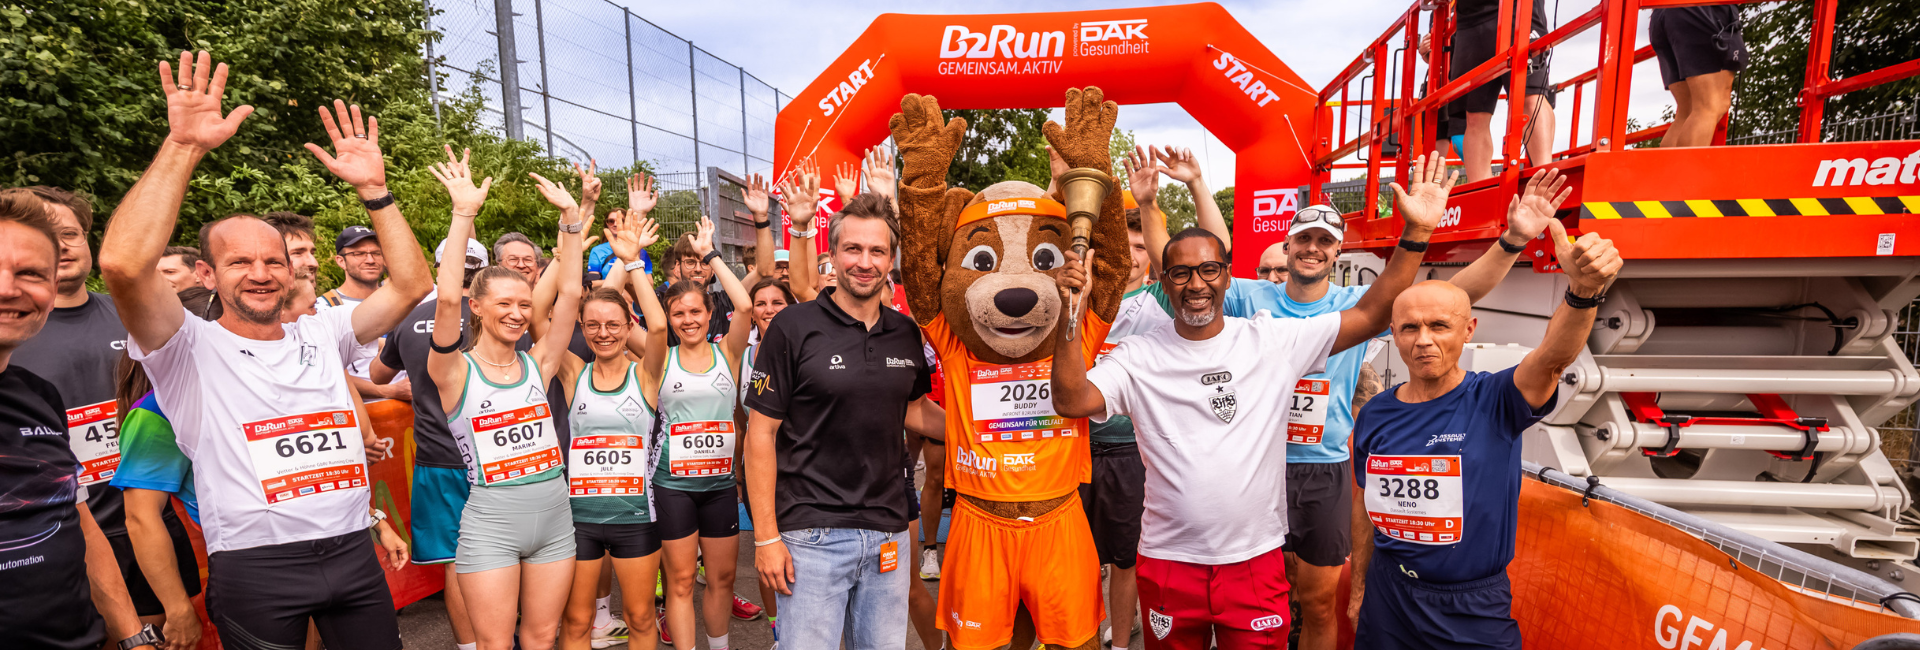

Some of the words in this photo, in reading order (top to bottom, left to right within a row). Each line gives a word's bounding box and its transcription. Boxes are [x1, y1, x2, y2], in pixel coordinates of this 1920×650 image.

[1081, 19, 1149, 42] DAK
[1072, 34, 1080, 57] powered
[1080, 40, 1149, 57] Gesundheit
[818, 58, 875, 117] START
[1213, 52, 1280, 107] START
[1811, 150, 1920, 187] mat
[1253, 188, 1298, 217] DA
[1000, 382, 1050, 402] 2026
[1014, 402, 1038, 410] BUDDY
[1290, 395, 1315, 412] 12
[85, 421, 119, 443] 45
[988, 421, 1025, 430] GEMEINSAM
[1025, 419, 1038, 428] FÜR
[1038, 418, 1065, 427] VIELFALT
[1312, 426, 1320, 434] D
[493, 422, 543, 447] 6607
[683, 435, 725, 449] 6603
[275, 431, 347, 458] 6621
[512, 442, 537, 451] MARIKA
[92, 455, 121, 468] STARTZEI
[584, 450, 631, 465] 6605
[1003, 453, 1036, 466] DAK
[292, 471, 325, 483] STARTZEIT
[354, 466, 361, 475] D
[1379, 477, 1440, 500] 3288
[1445, 519, 1454, 529] D
